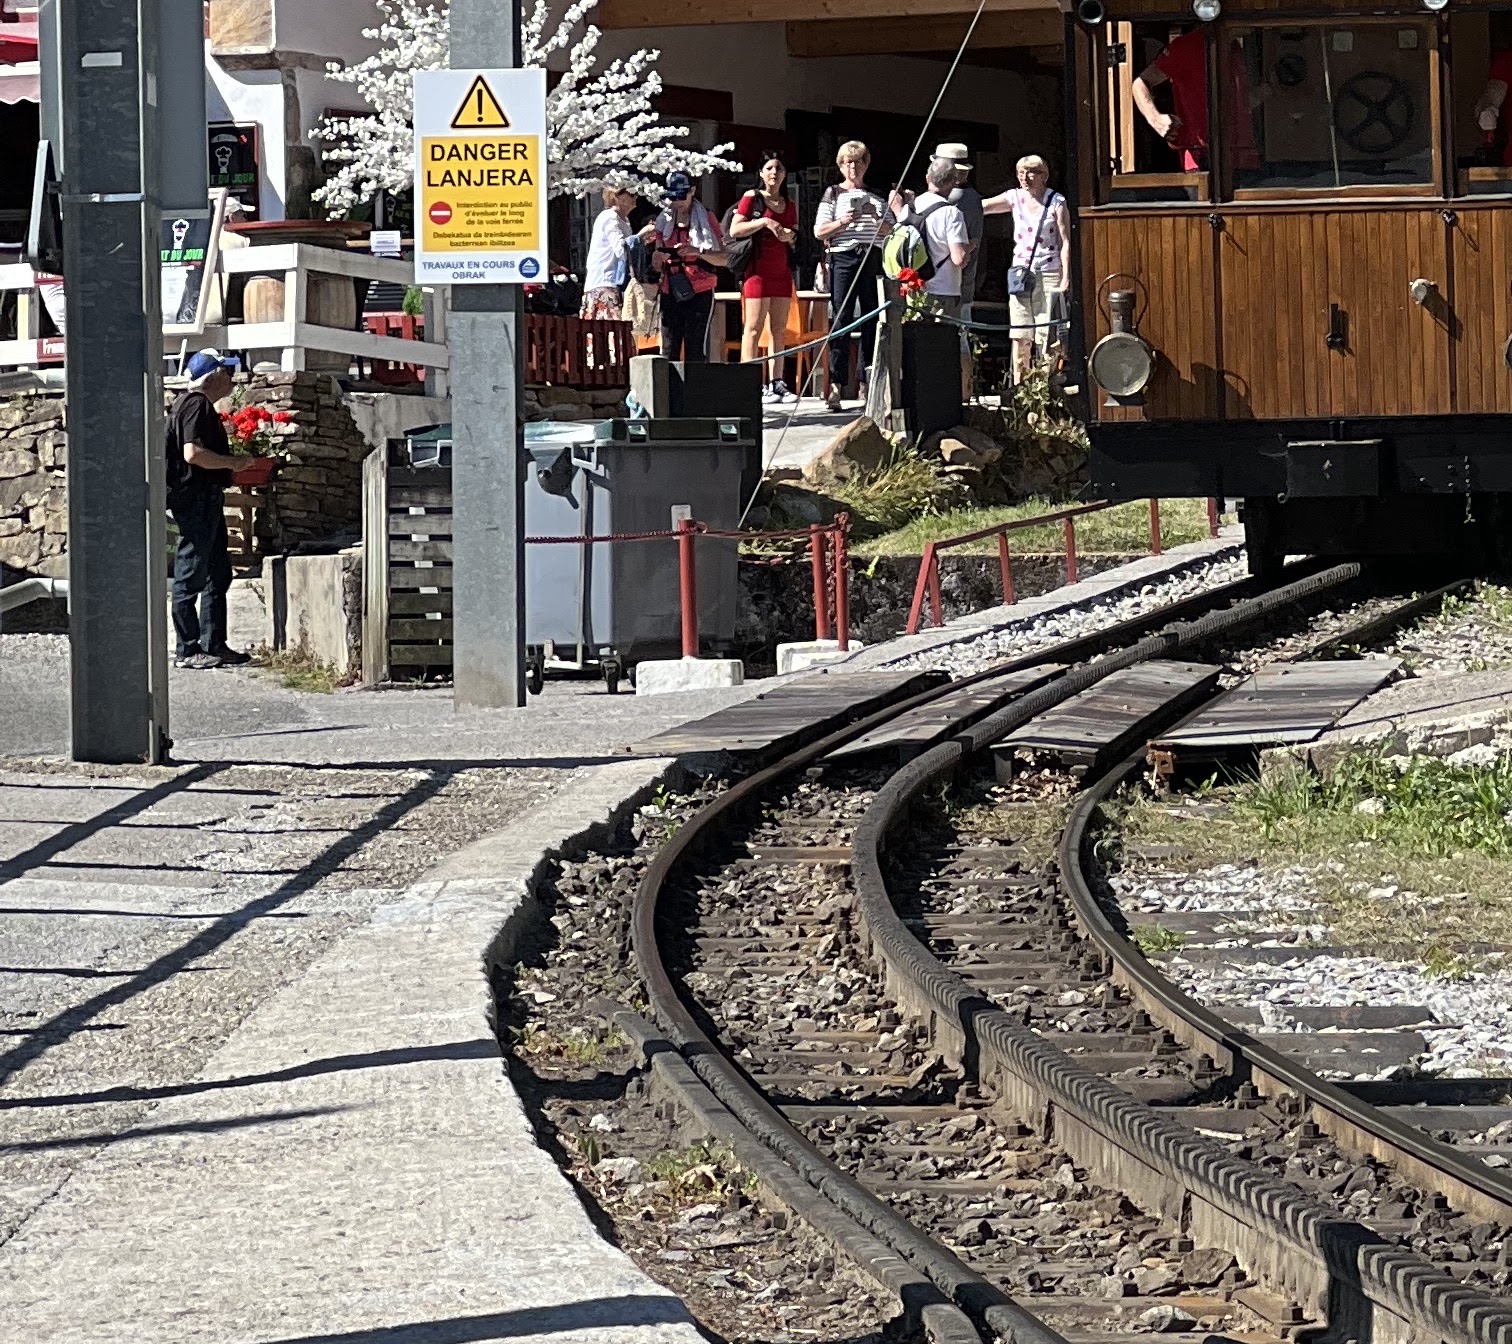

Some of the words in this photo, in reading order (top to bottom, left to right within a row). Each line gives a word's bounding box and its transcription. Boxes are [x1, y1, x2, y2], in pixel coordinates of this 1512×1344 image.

[430, 143, 529, 162] DANGER
[426, 168, 534, 187] LANJERA
[510, 201, 533, 209] public
[183, 248, 204, 261] JOUR
[422, 261, 465, 270] TRAVAUX
[467, 261, 480, 269] EN
[482, 260, 515, 269] COURS
[451, 271, 486, 280] OBRAK
